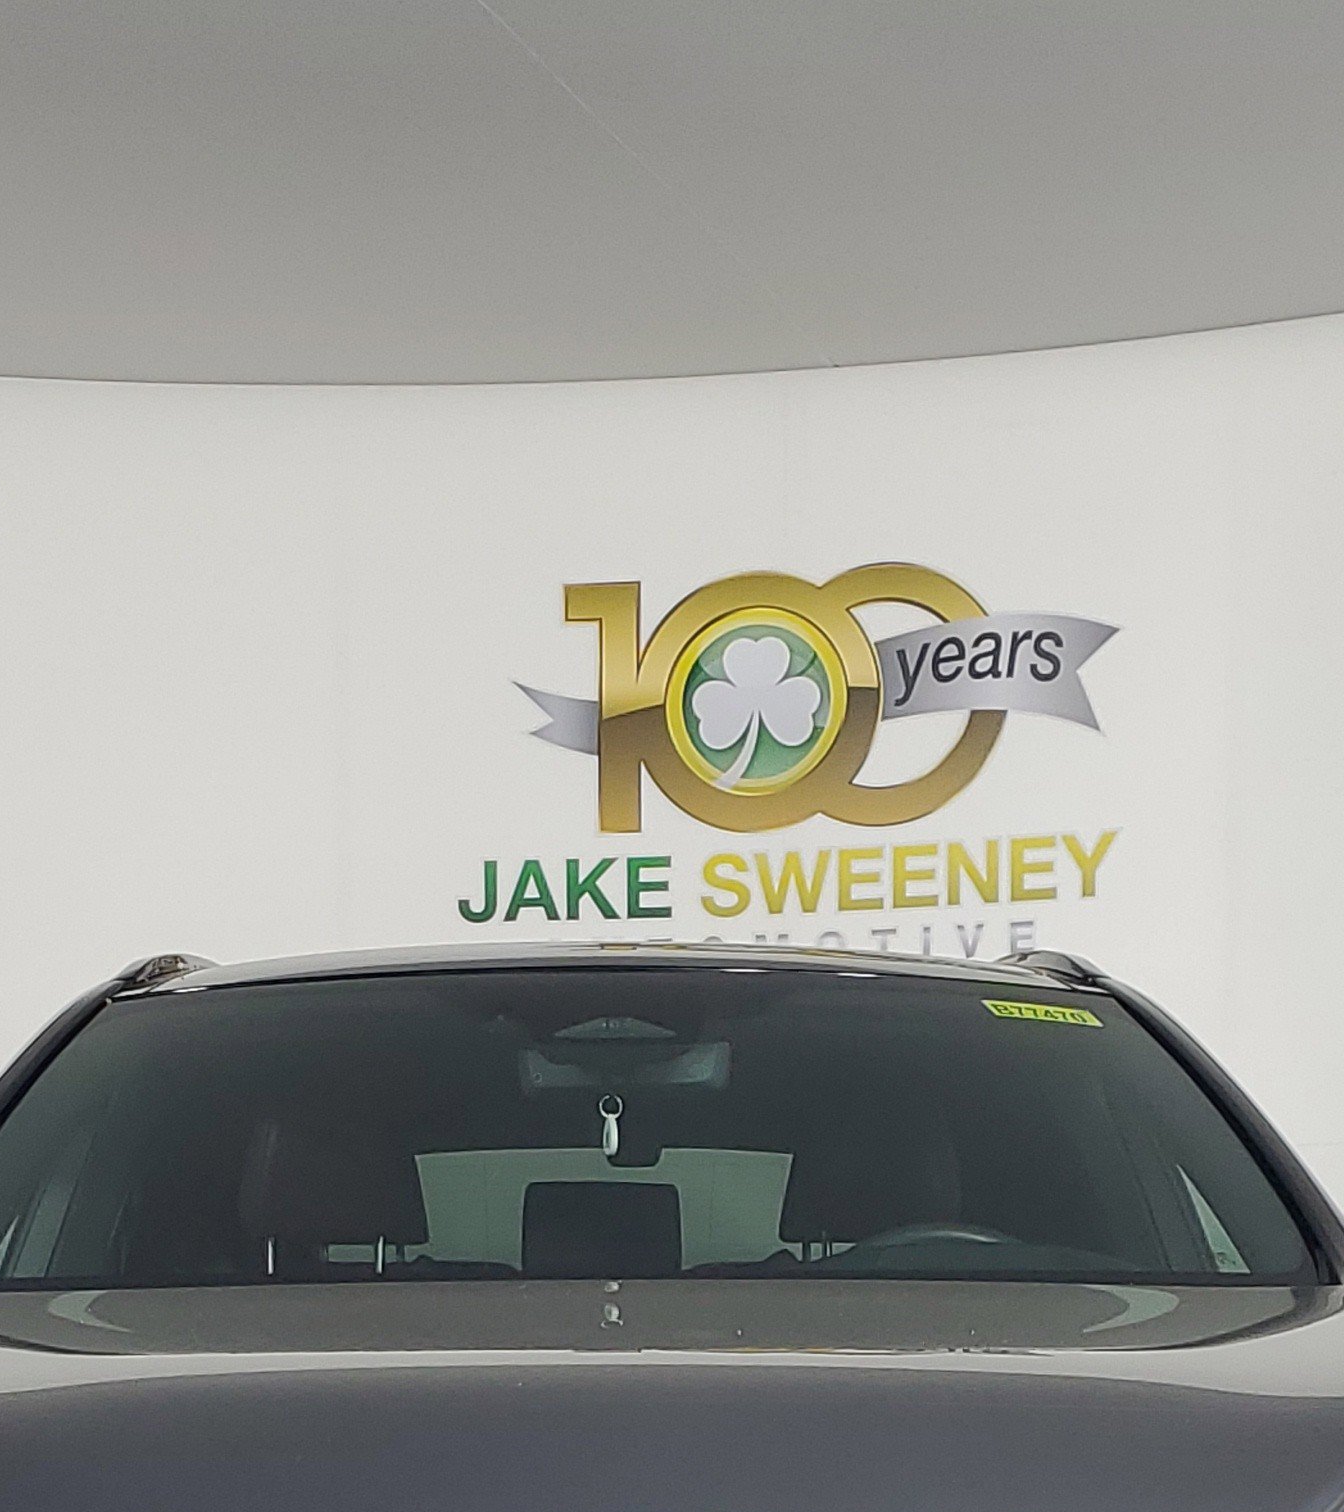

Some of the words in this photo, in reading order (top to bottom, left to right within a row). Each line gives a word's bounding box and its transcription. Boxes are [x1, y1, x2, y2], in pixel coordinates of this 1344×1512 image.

[563, 561, 1007, 833] 100
[894, 630, 1063, 706] years
[457, 856, 673, 923] JAKE
[700, 832, 1116, 918] SWEENEY
